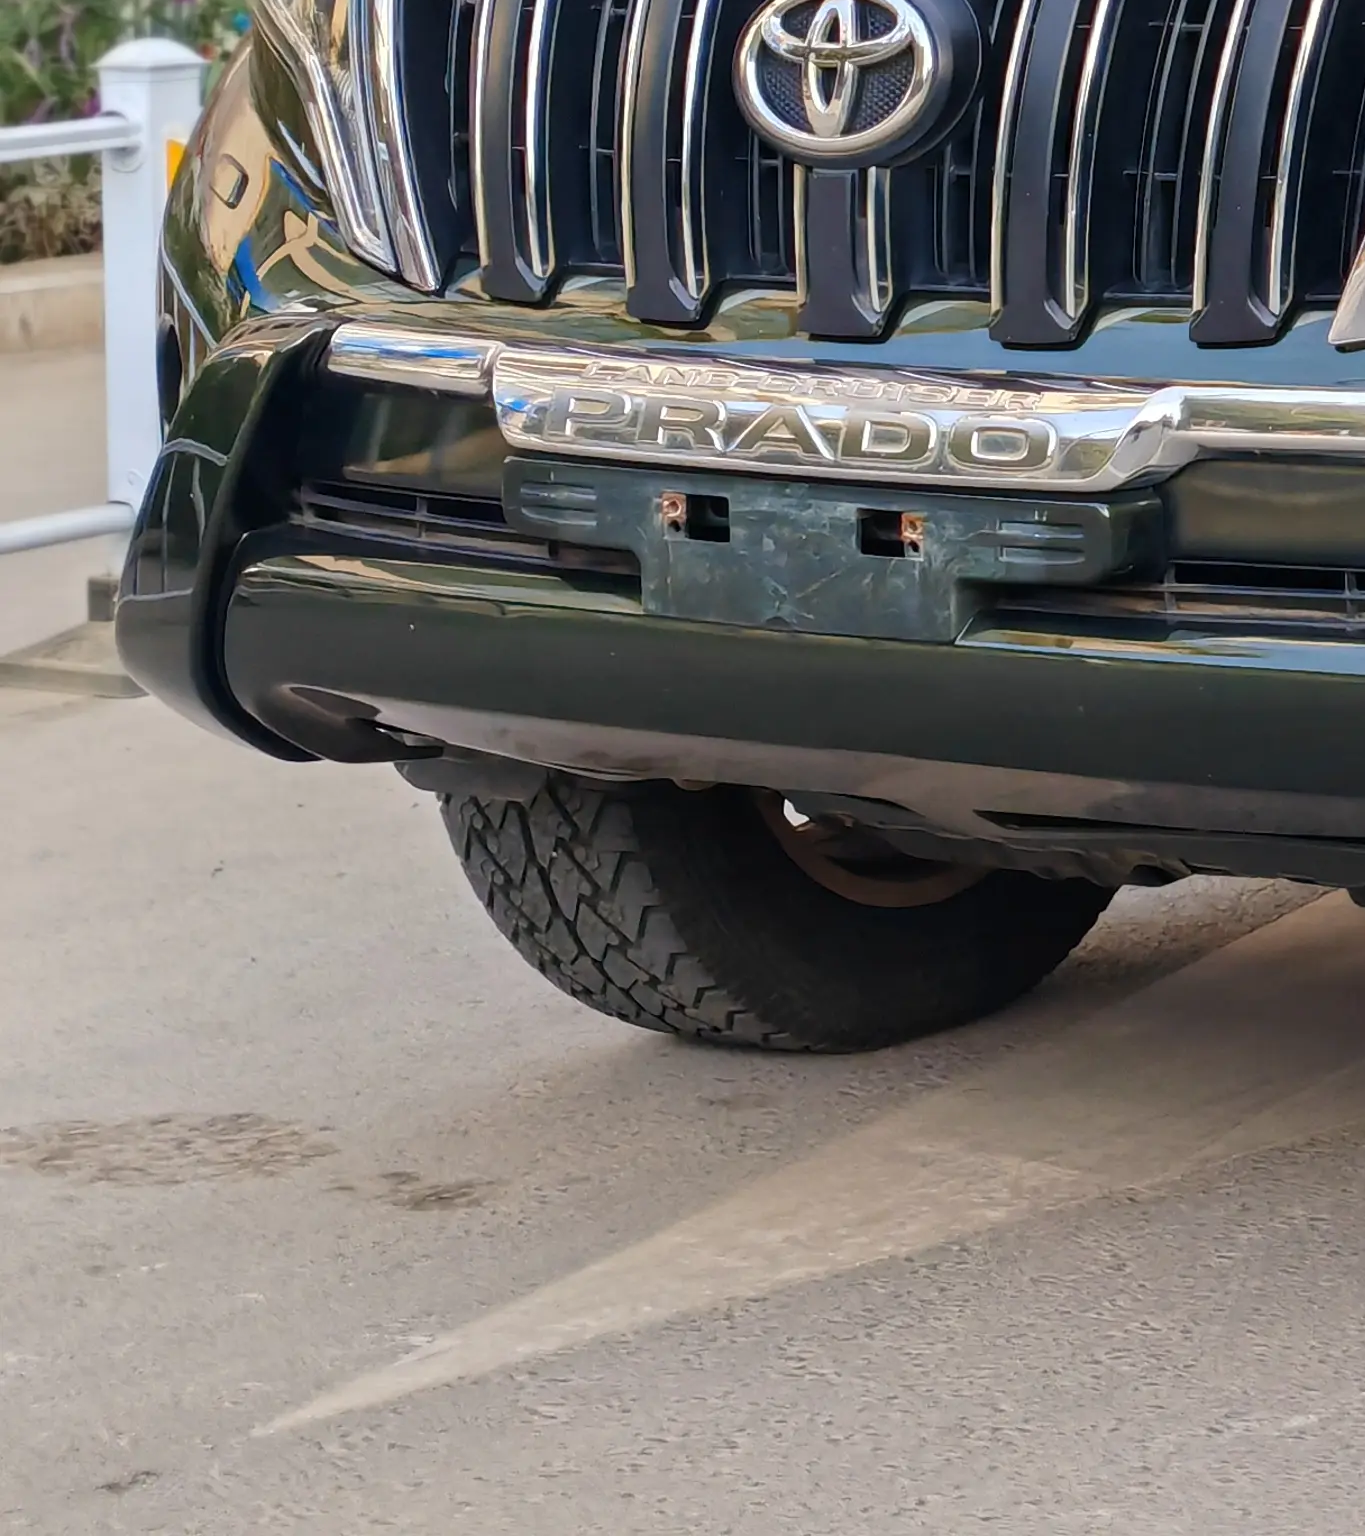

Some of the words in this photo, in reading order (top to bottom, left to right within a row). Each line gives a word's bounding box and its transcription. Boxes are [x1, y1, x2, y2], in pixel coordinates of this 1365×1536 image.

[581, 360, 740, 388] LAND
[756, 373, 1044, 412] CRUISER
[546, 387, 1058, 472] PRADO
